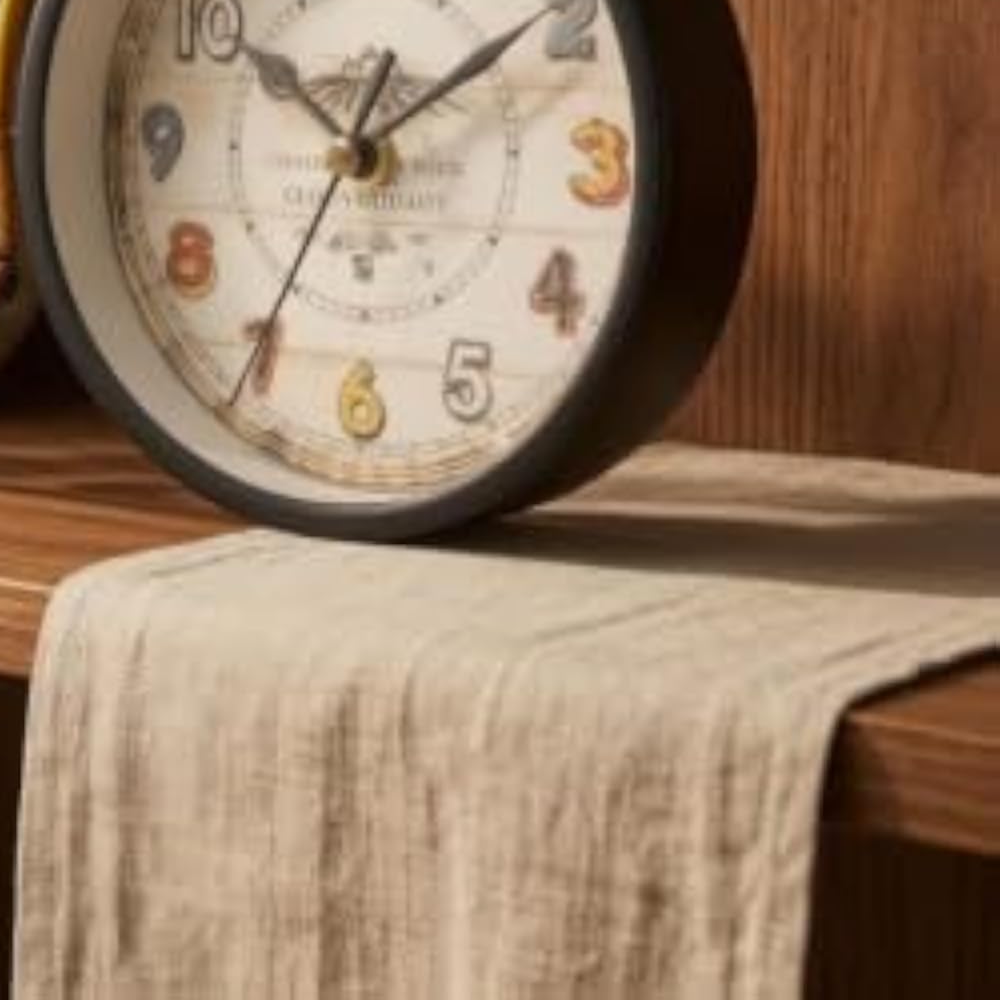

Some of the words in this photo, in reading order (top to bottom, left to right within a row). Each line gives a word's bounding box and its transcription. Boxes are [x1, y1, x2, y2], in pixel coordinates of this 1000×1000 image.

[142, 103, 184, 181] 9
[568, 116, 630, 208] 3
[166, 220, 216, 299] 8
[530, 246, 587, 338] 4
[339, 357, 386, 440] 6
[443, 339, 493, 422] 5
